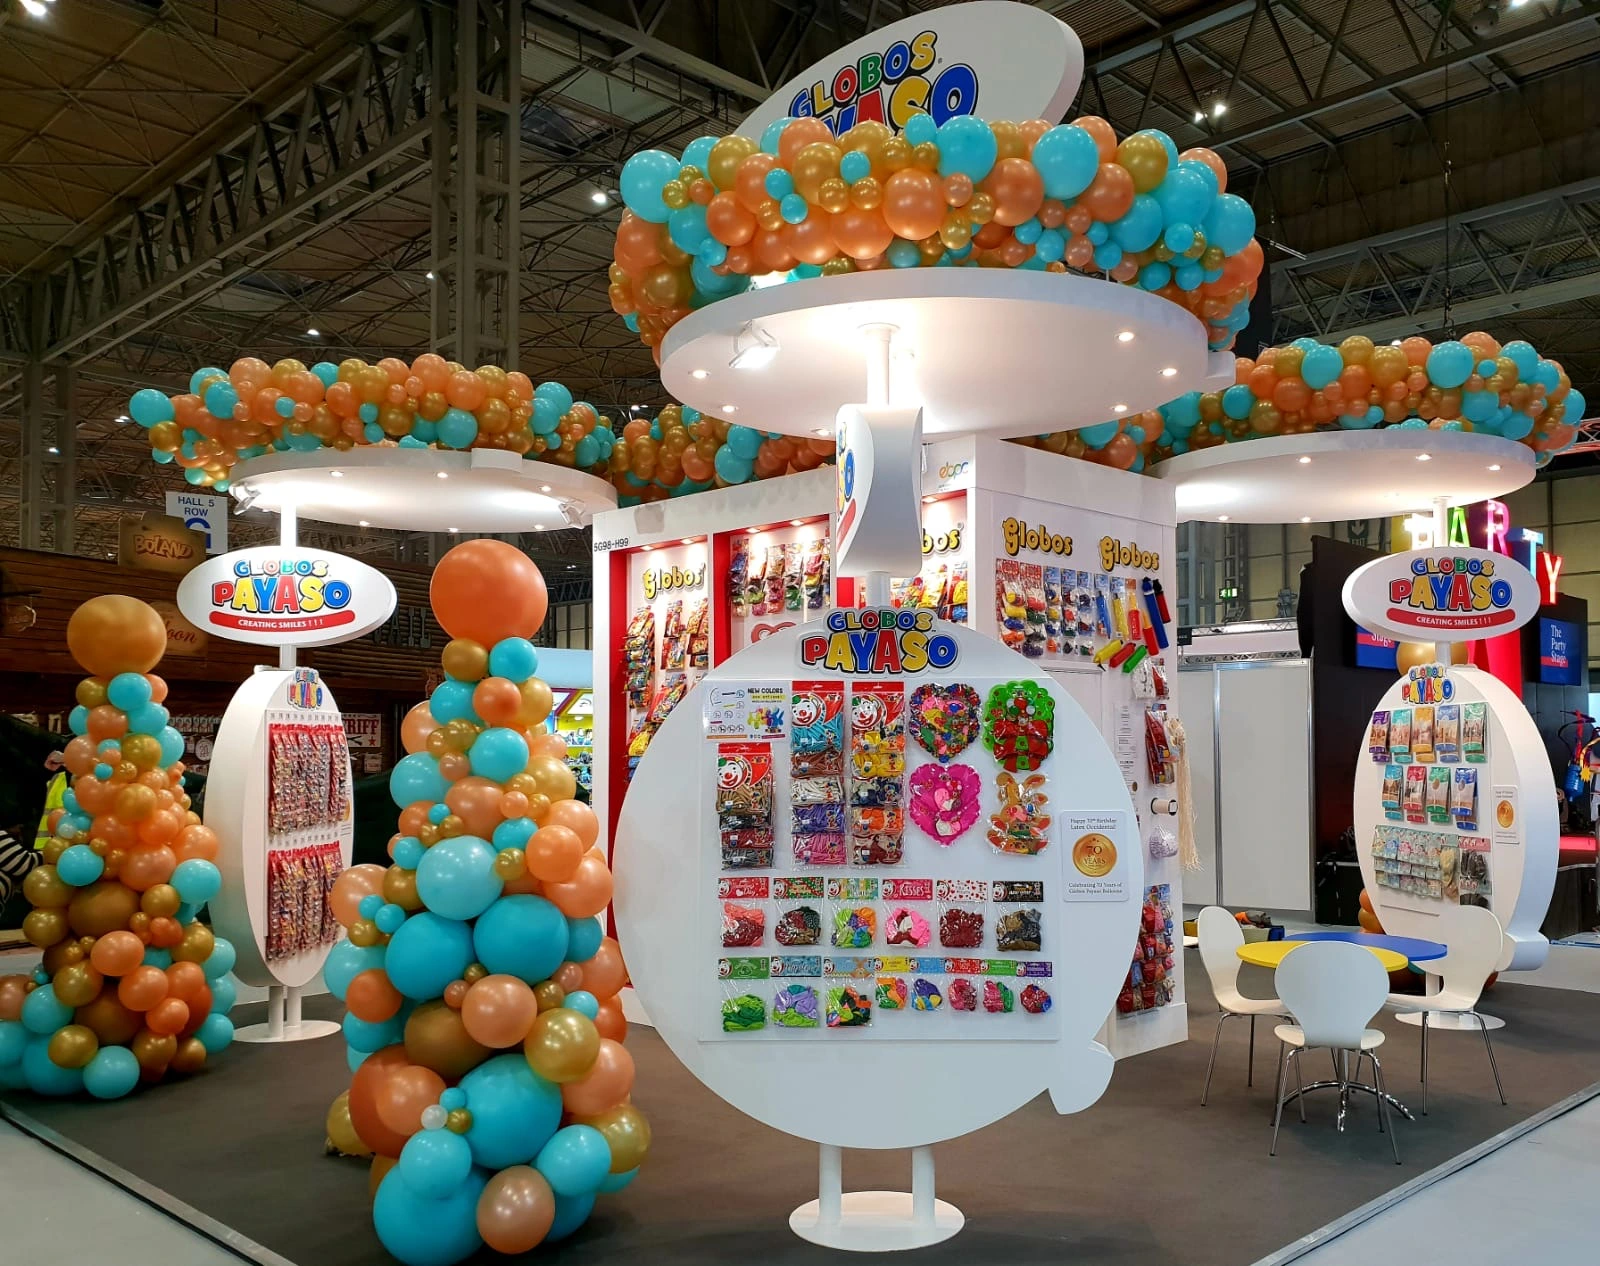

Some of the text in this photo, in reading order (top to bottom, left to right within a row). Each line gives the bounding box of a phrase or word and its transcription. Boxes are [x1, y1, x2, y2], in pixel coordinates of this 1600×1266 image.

[789, 30, 938, 118] GLOBOS
[822, 63, 978, 140] YASO
[178, 496, 215, 507] HALL 5
[184, 507, 209, 517] ROW
[133, 534, 194, 559] BOLAND
[922, 528, 961, 554] bos
[1002, 517, 1073, 557] Globos
[1100, 536, 1160, 573] Globos
[234, 559, 329, 577] GLOBOS
[1411, 557, 1495, 576] GLOBOS
[212, 575, 352, 613] PAYASO
[1389, 573, 1512, 611] PAYASO
[238, 619, 278, 629] CREATING
[279, 620, 307, 629] SMILES
[827, 609, 934, 632] GLOBOS
[1416, 616, 1453, 626] CREATING
[1454, 617, 1478, 626] SMILES
[1550, 624, 1562, 638] The
[800, 624, 959, 674] PAYASO
[1550, 638, 1567, 653] Party
[1550, 652, 1568, 666] Stage
[1409, 666, 1445, 680] GLOBOS
[288, 683, 323, 708] PAYASO
[1402, 678, 1453, 703] PAYASO
[342, 718, 380, 735] RIFF
[1084, 857, 1106, 865] YEARS
[899, 883, 925, 897] KISSES
